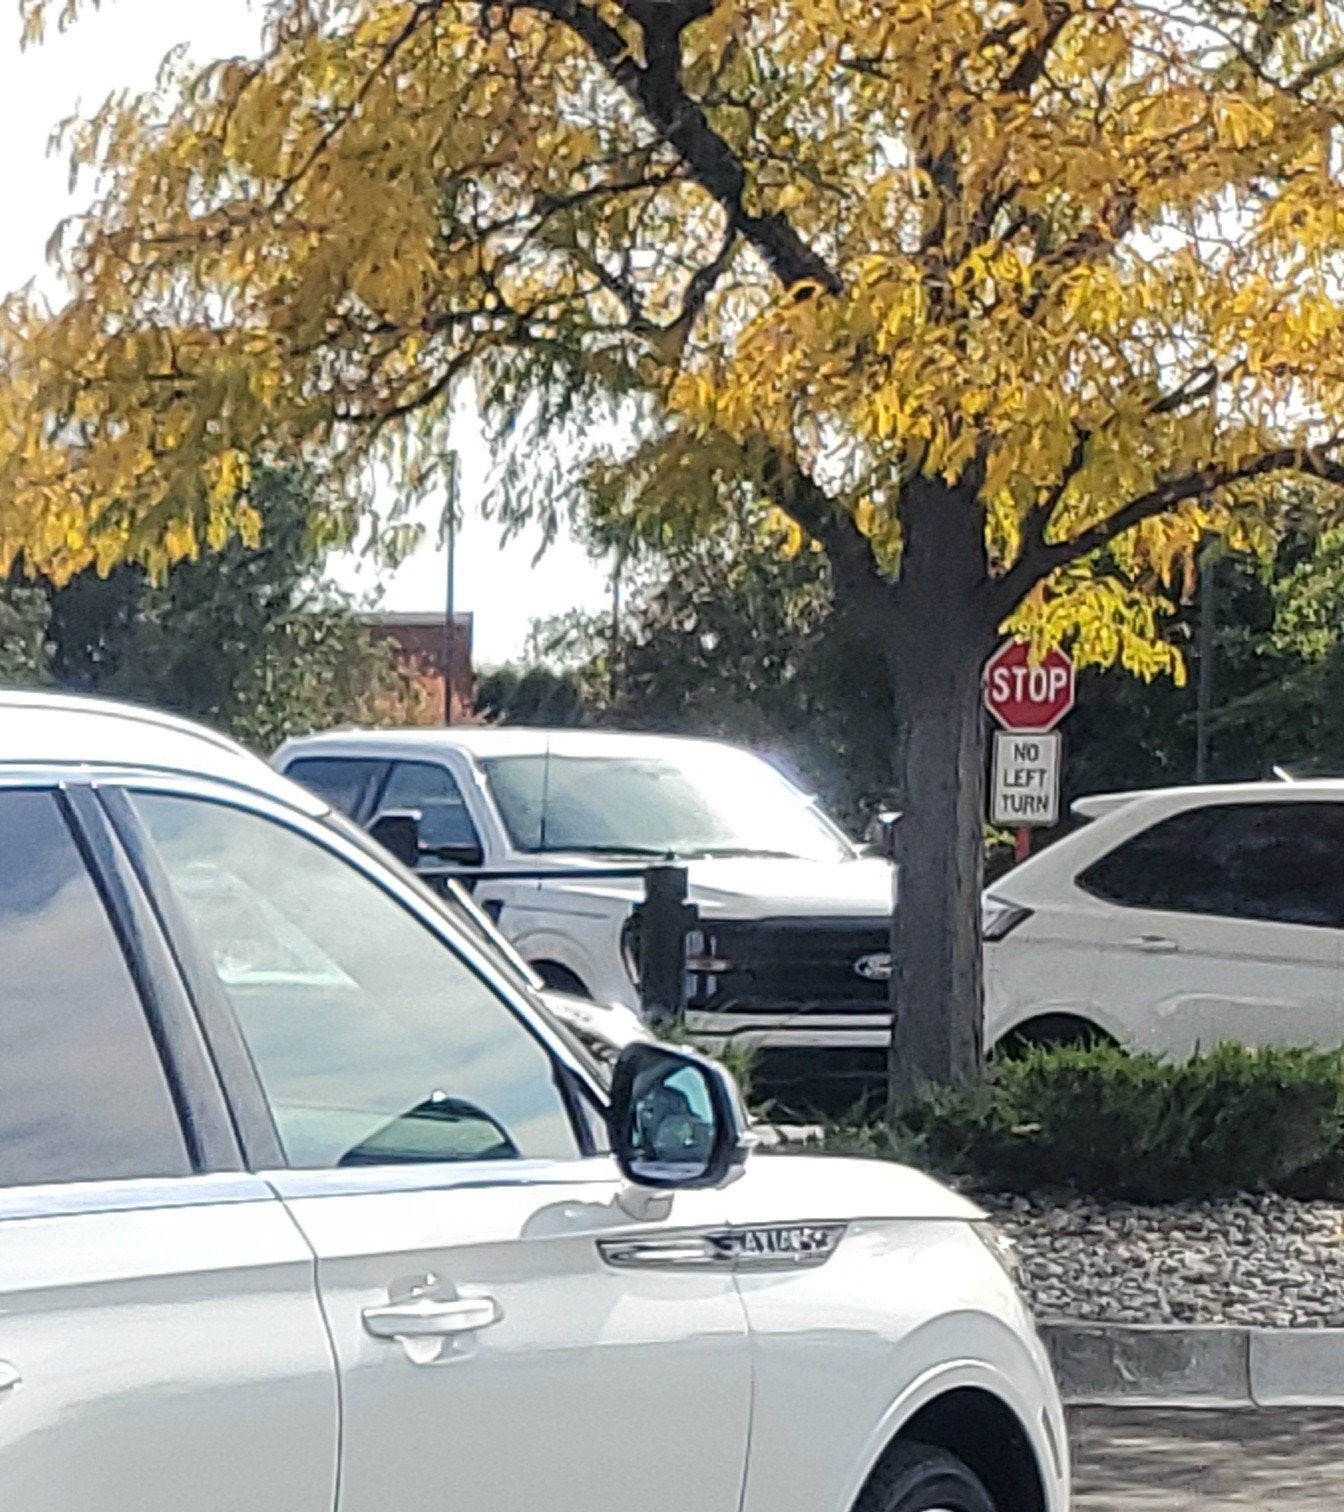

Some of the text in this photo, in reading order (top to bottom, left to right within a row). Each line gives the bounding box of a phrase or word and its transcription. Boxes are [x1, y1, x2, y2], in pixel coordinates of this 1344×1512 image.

[992, 666, 1068, 703] STOP
[1013, 742, 1040, 762] NO
[1003, 768, 1048, 787] LEFT
[1000, 795, 1049, 813] TURN
